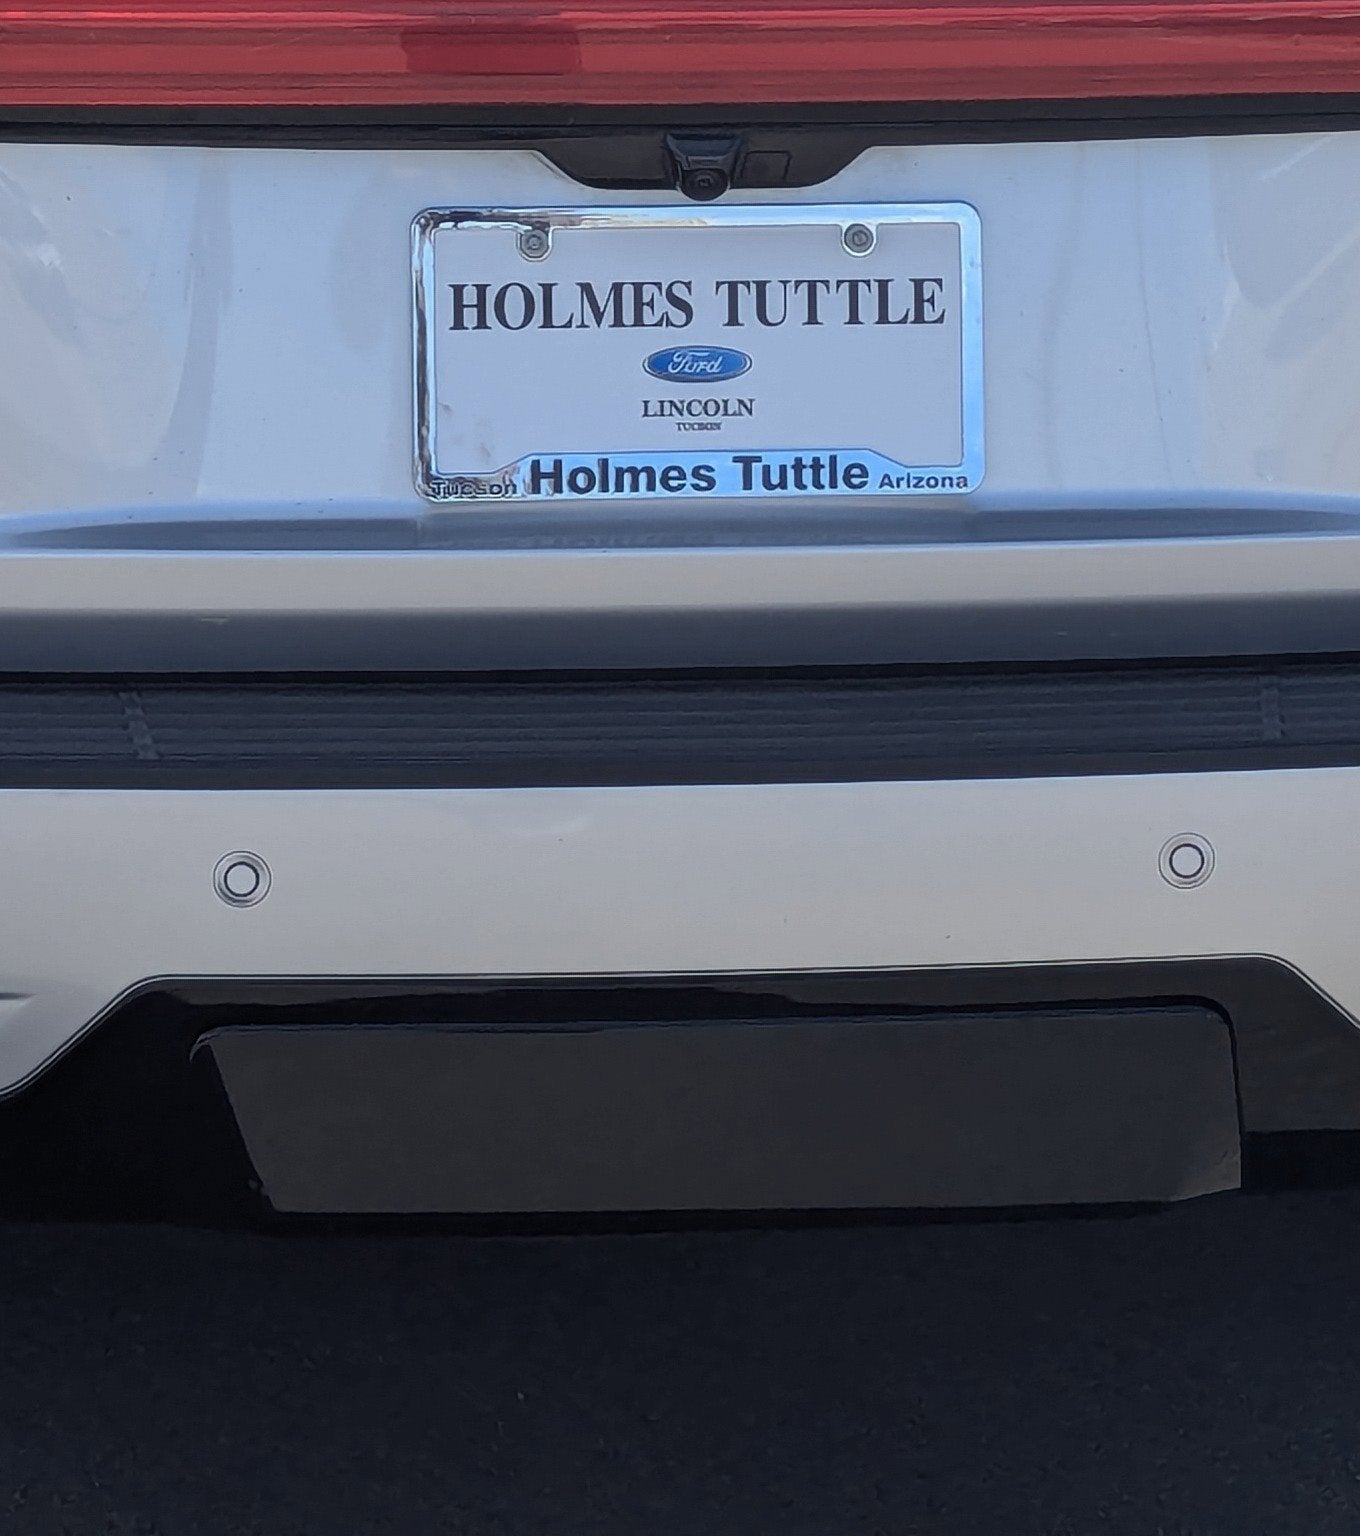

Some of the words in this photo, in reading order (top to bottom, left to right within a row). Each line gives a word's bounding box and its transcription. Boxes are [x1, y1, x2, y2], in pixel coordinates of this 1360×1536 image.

[447, 279, 694, 331] HOLMES
[715, 277, 947, 327] TUTTLE
[667, 349, 723, 374] Ford
[641, 397, 756, 418] LINCOLN
[530, 458, 716, 495] Holmes
[731, 454, 870, 492] Tuttle
[878, 472, 969, 490] Arizona
